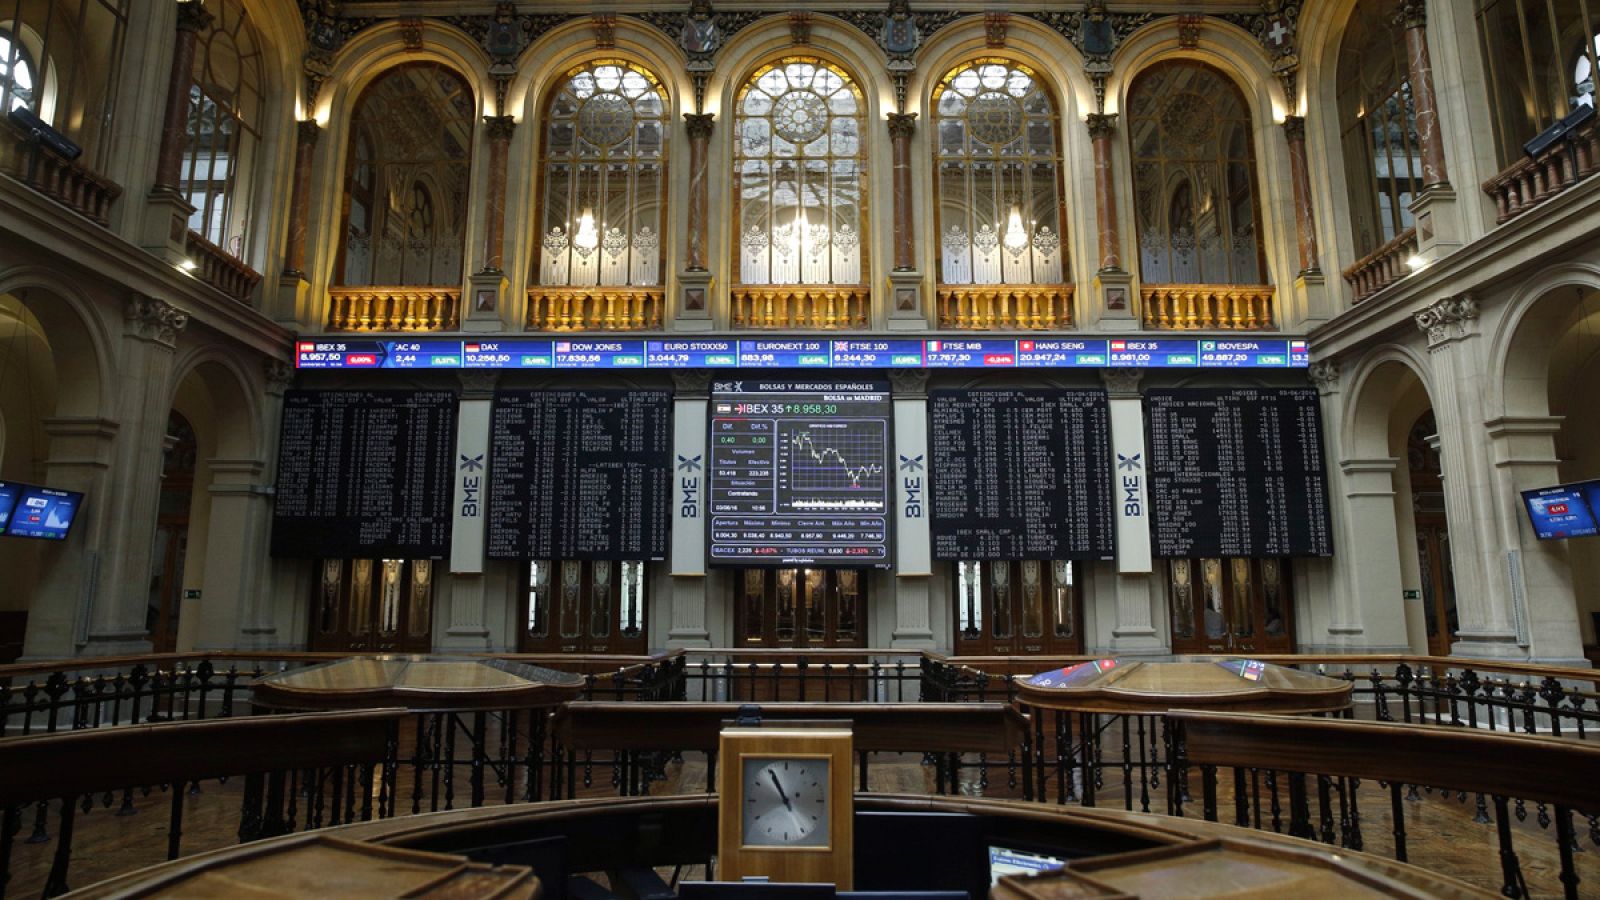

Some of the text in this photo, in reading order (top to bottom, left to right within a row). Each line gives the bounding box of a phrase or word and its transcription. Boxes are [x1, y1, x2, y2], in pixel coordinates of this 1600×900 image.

[316, 344, 346, 352] IBEX 35
[396, 344, 420, 352] AC 40
[836, 382, 873, 390] ESPAÑOLES
[744, 404, 837, 414] IBEX 35 8.958,30
